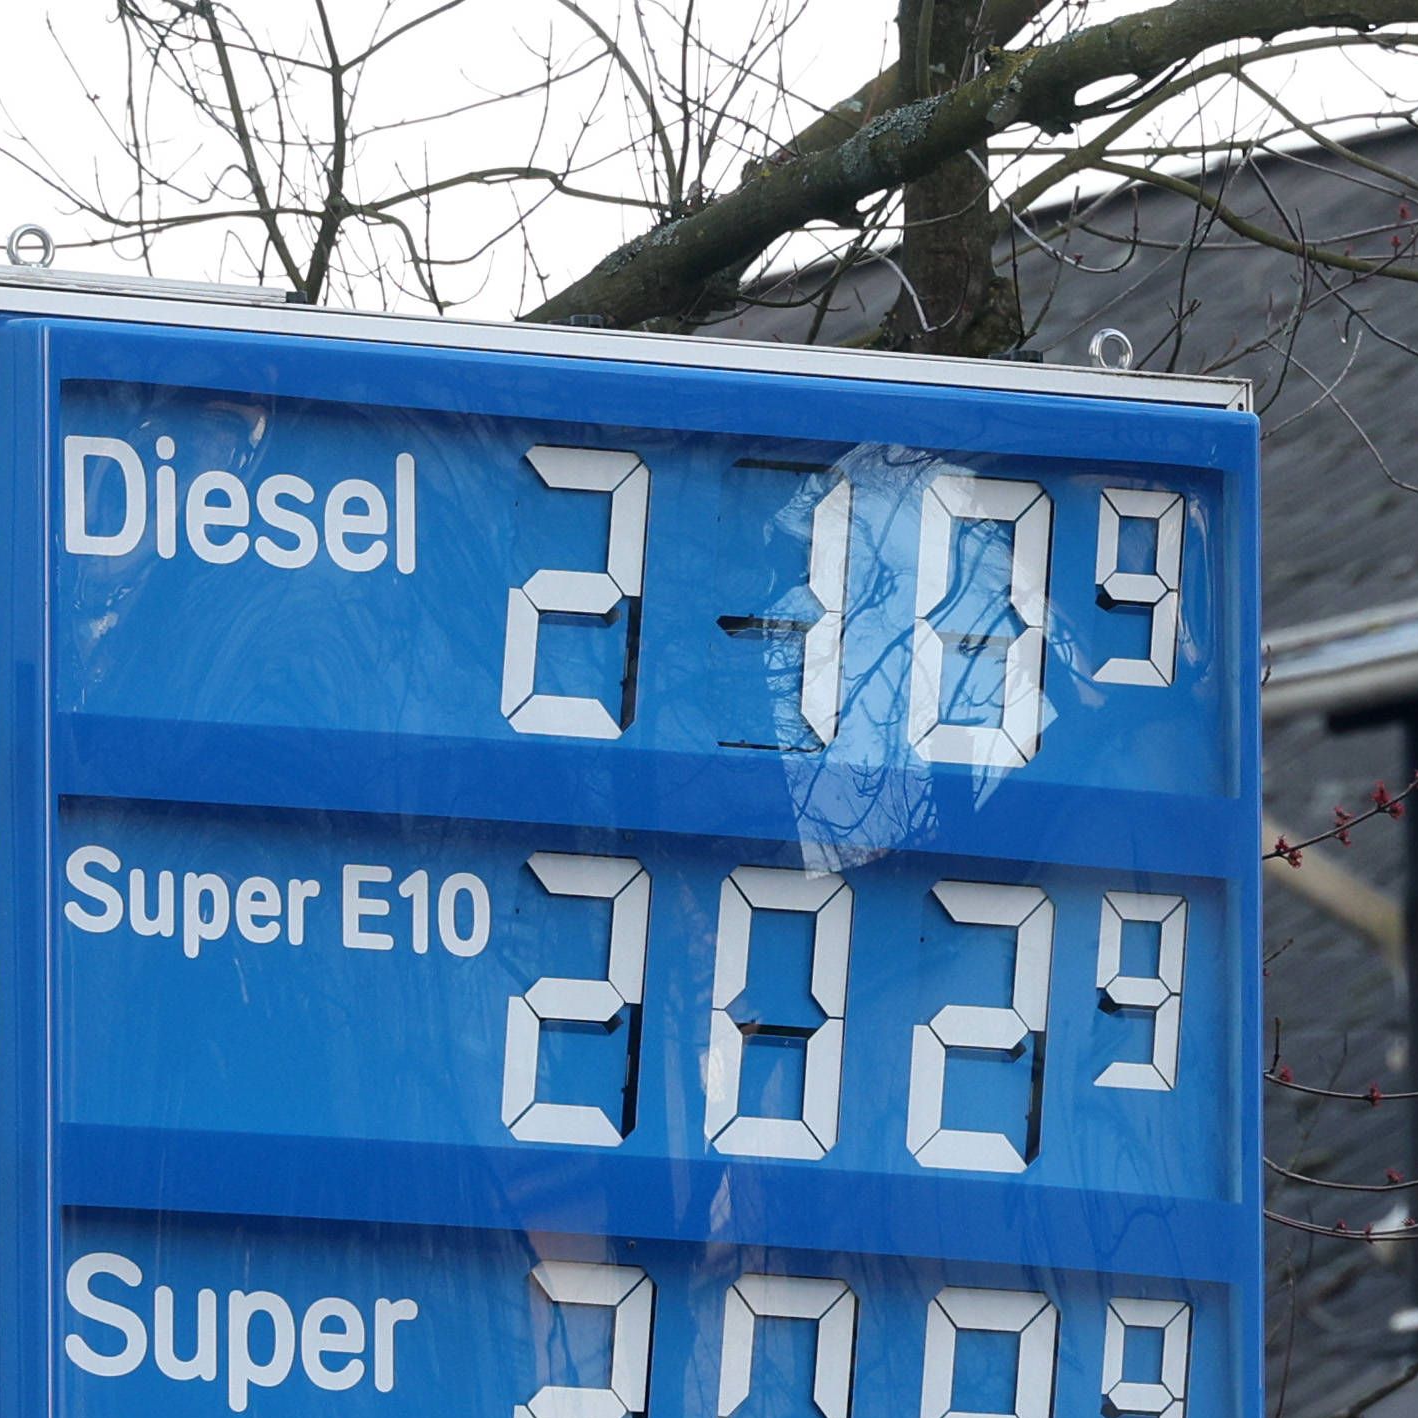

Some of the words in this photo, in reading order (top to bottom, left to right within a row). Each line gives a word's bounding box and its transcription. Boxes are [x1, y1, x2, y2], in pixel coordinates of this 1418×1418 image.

[65, 436, 415, 574] Diesel
[65, 845, 320, 958] Super
[343, 864, 490, 956] E10
[66, 1253, 418, 1412] Super
